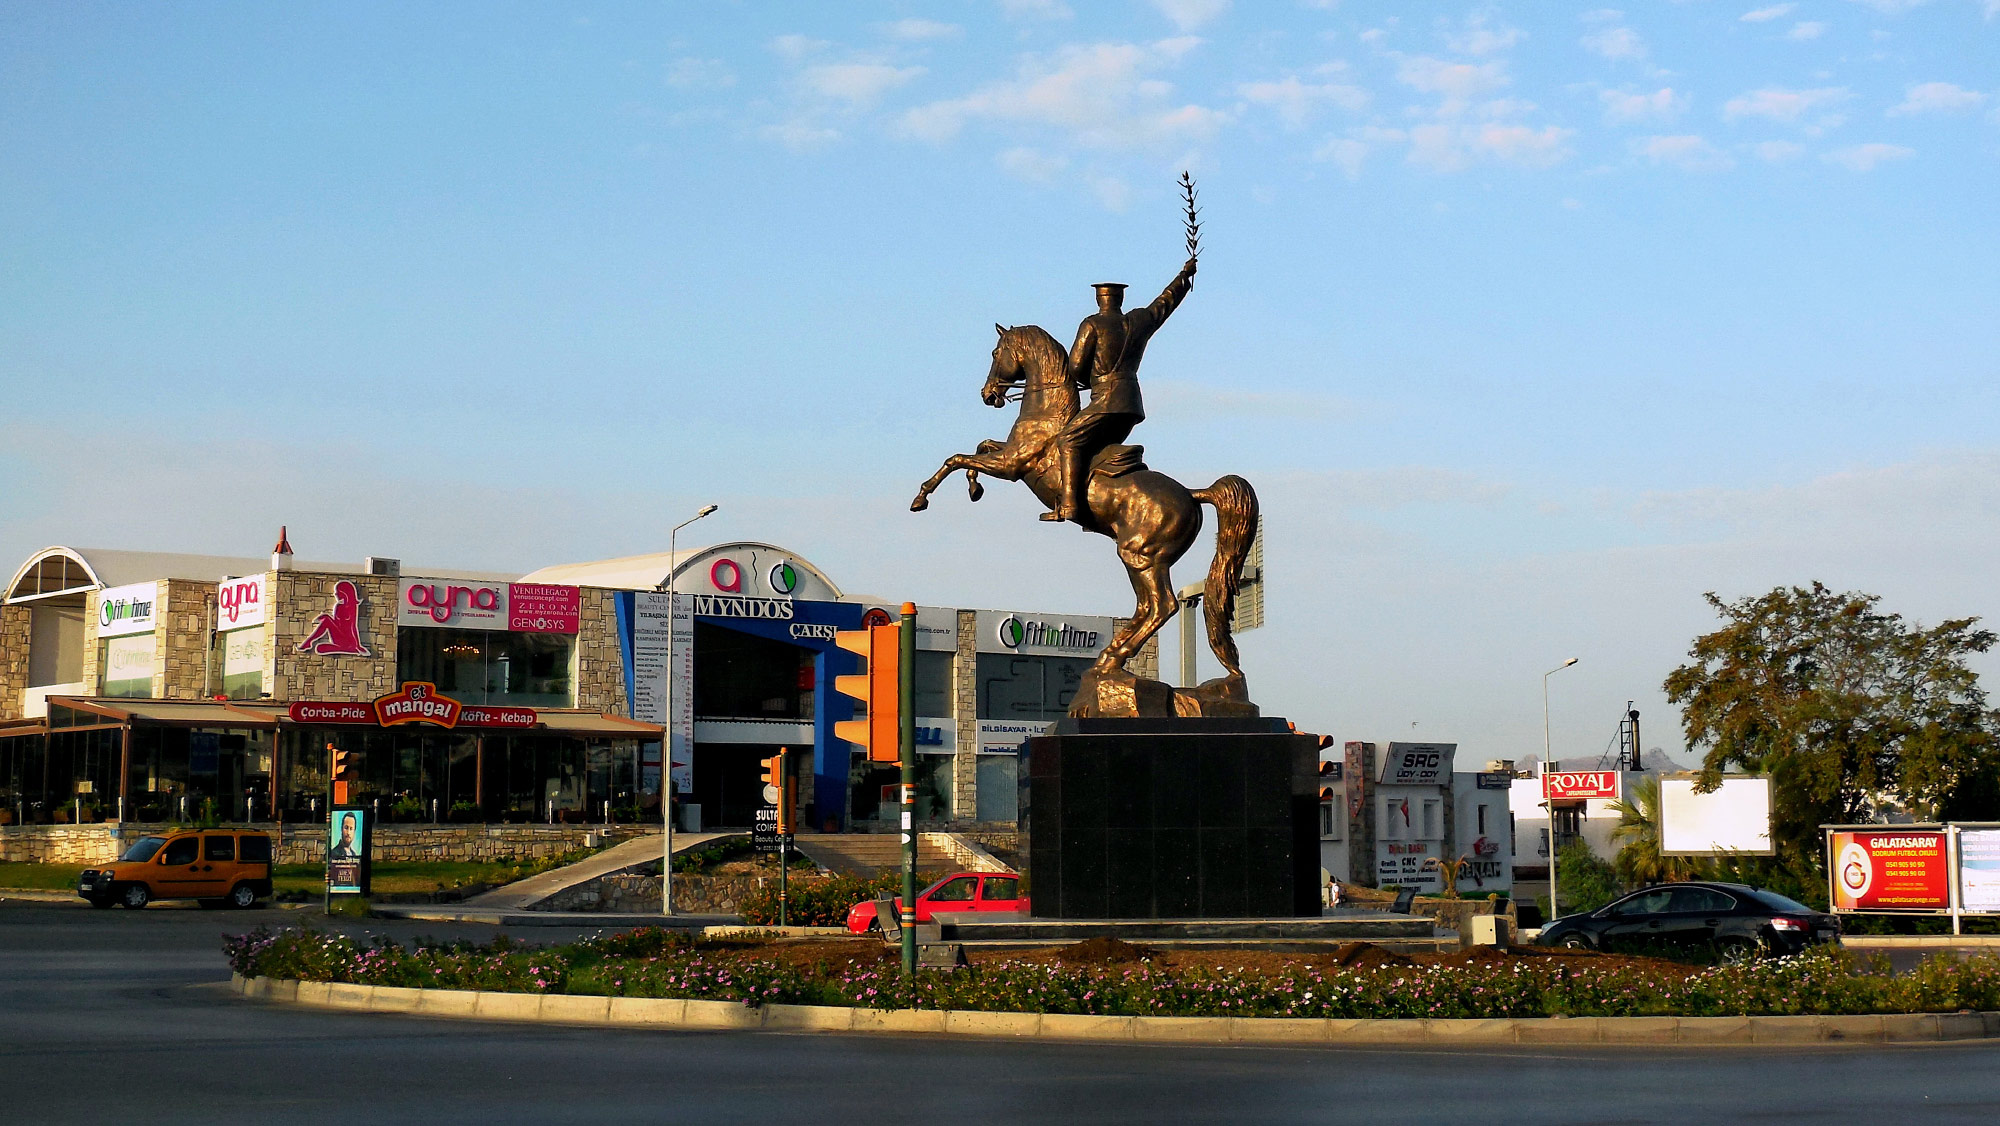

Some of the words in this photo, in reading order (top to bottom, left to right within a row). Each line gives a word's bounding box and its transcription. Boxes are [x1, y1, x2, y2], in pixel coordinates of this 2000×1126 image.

[220, 582, 258, 622] ayna
[407, 584, 497, 623] ayna
[694, 597, 794, 619] MYNDOS
[789, 623, 838, 642] ÇARŞI
[1024, 621, 1098, 648] fitintime
[411, 684, 427, 700] et
[300, 706, 366, 719] Çorba-Pide
[385, 699, 452, 719] mangal
[461, 710, 491, 722] Köfte
[500, 712, 534, 724] Kebap
[981, 724, 1027, 733] BİLGİSAYAR
[1403, 753, 1440, 768] SRC
[1545, 774, 1614, 793] ROYAL
[756, 810, 778, 821] SULTA
[756, 823, 778, 832] COIFF
[1870, 837, 1938, 849] GALATASARAY
[1401, 857, 1417, 866] CNC
